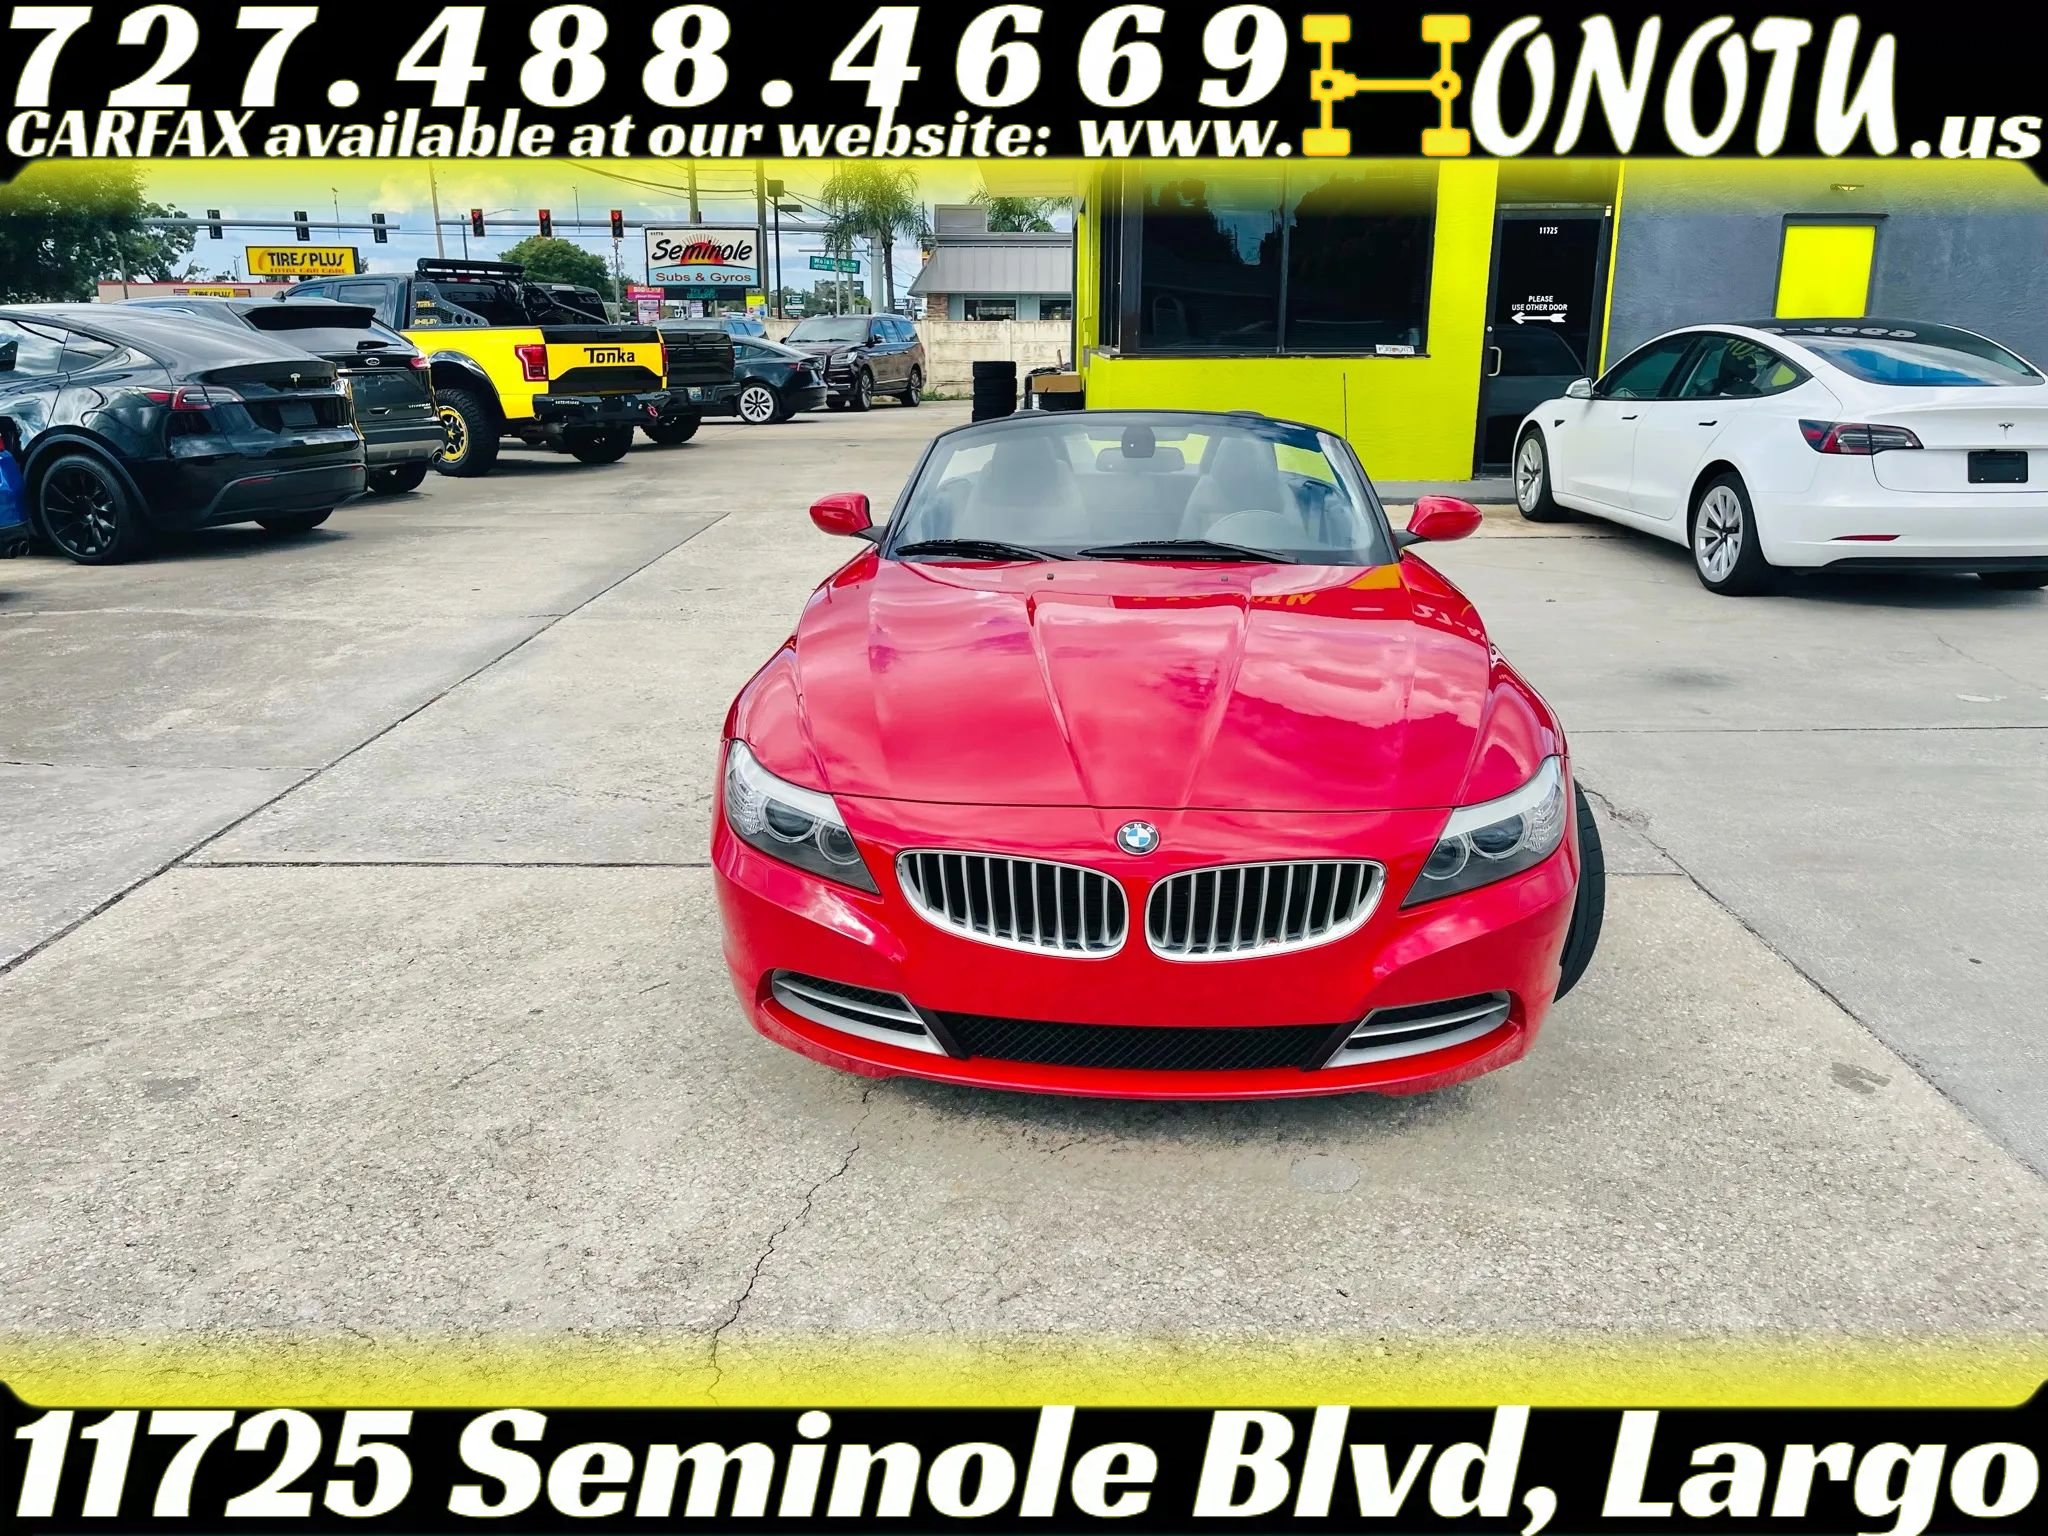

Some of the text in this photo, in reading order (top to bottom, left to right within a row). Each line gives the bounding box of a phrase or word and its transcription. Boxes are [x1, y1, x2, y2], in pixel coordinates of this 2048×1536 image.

[1539, 226, 1558, 235] 11725
[651, 238, 753, 261] Seminole
[813, 257, 857, 267] Walsinham
[655, 272, 752, 284] Subs & Gyros
[1528, 295, 1554, 303] PLEASE
[1511, 303, 1568, 311] USE OTHER DOOR
[583, 346, 636, 364] Tonka
